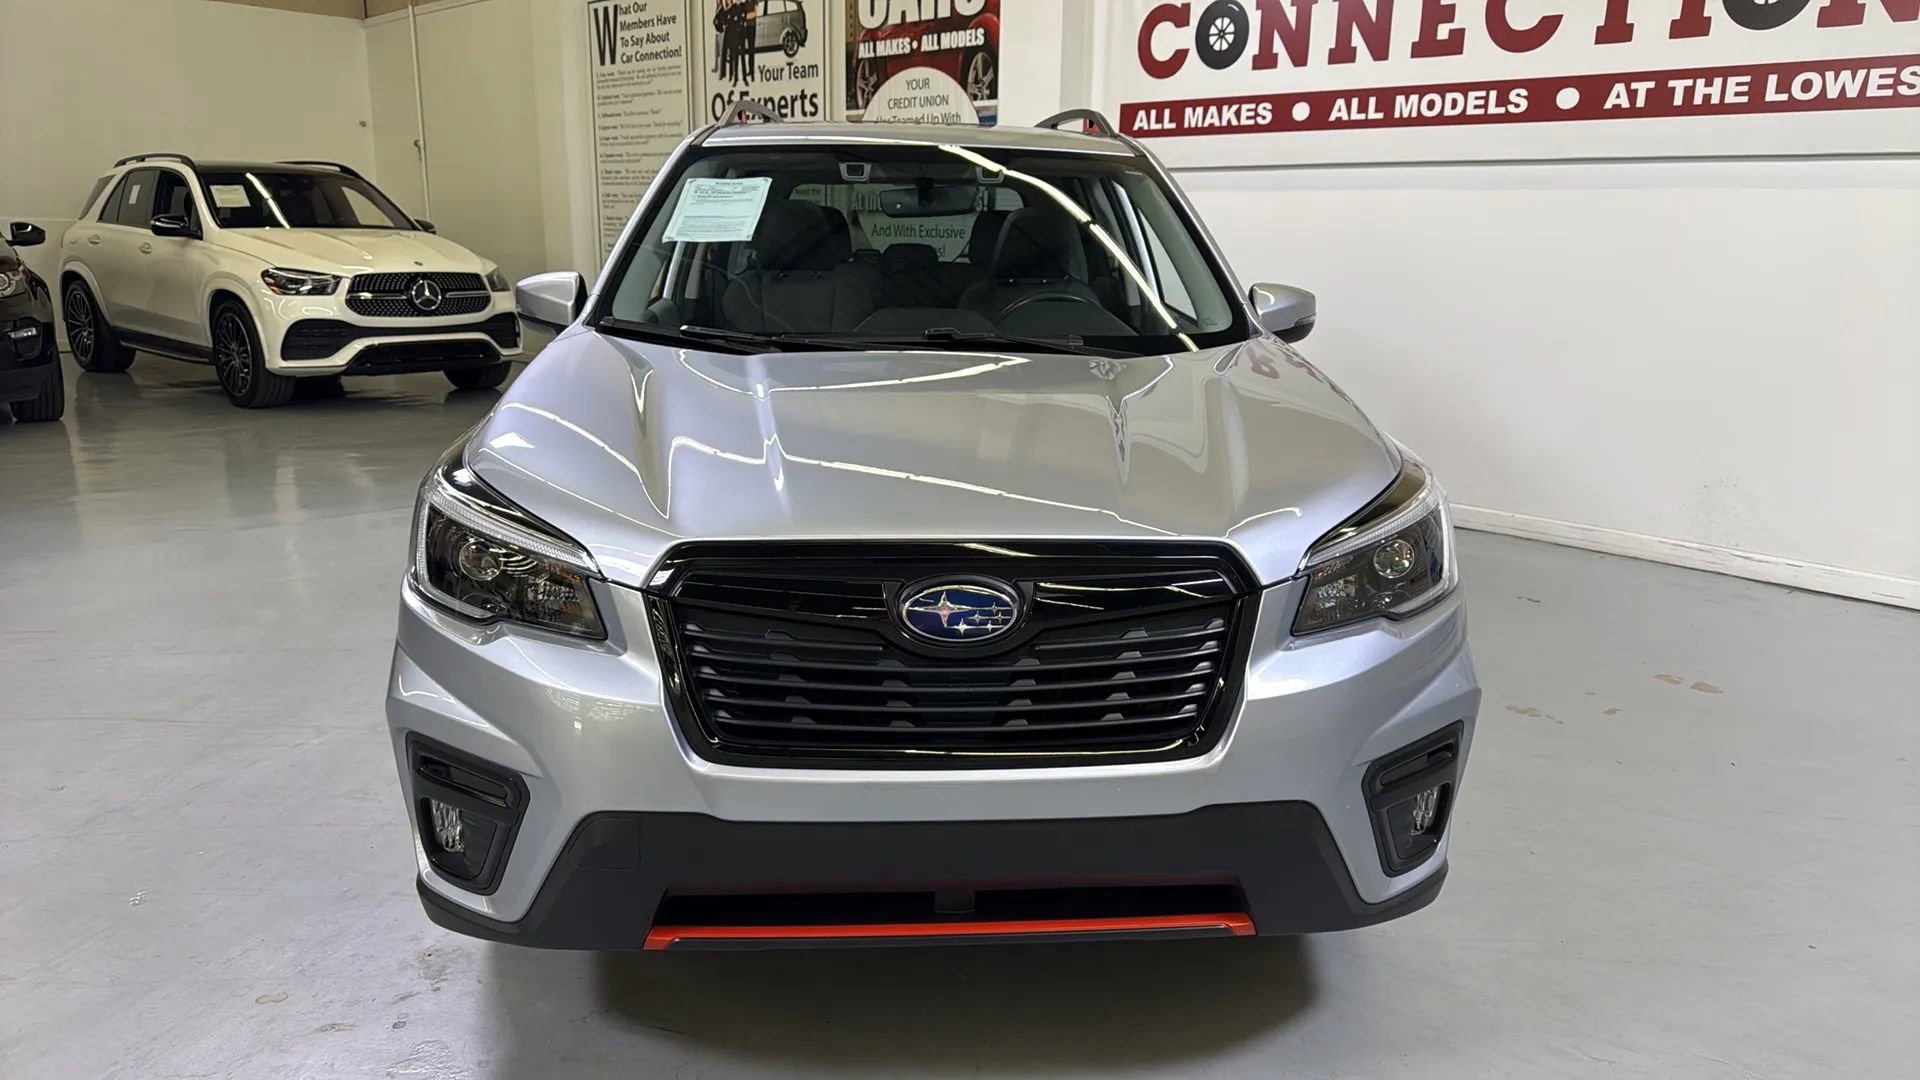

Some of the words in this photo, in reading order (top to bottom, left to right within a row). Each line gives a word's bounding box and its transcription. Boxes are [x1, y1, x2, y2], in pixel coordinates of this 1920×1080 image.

[632, 2, 647, 14] Our
[620, 17, 655, 32] Members
[656, 15, 677, 26] Have
[620, 36, 629, 48] To
[630, 35, 644, 48] Say
[645, 32, 670, 44] About
[858, 41, 875, 59] ALL
[876, 37, 911, 57] MAKES
[921, 33, 939, 52] ALL
[940, 28, 985, 50] MODELS
[1137, 0, 1920, 80] CONNEC
[620, 53, 633, 64] Car
[634, 46, 682, 62] Connection!
[758, 64, 784, 82] Your
[786, 62, 819, 79] Team
[906, 78, 930, 90] YOUR
[887, 97, 919, 110] CREDIT
[919, 94, 949, 107] UNION
[1132, 109, 1177, 131] ALL
[1184, 103, 1273, 129] MAKES
[1328, 97, 1384, 122] ALL
[1394, 88, 1529, 119] MODELS
[1603, 82, 1656, 110] AT
[1667, 76, 1752, 106] THE
[1764, 65, 1920, 102] LOWES
[871, 223, 892, 237] And
[893, 224, 916, 238] With
[918, 225, 966, 239] Exclusive
